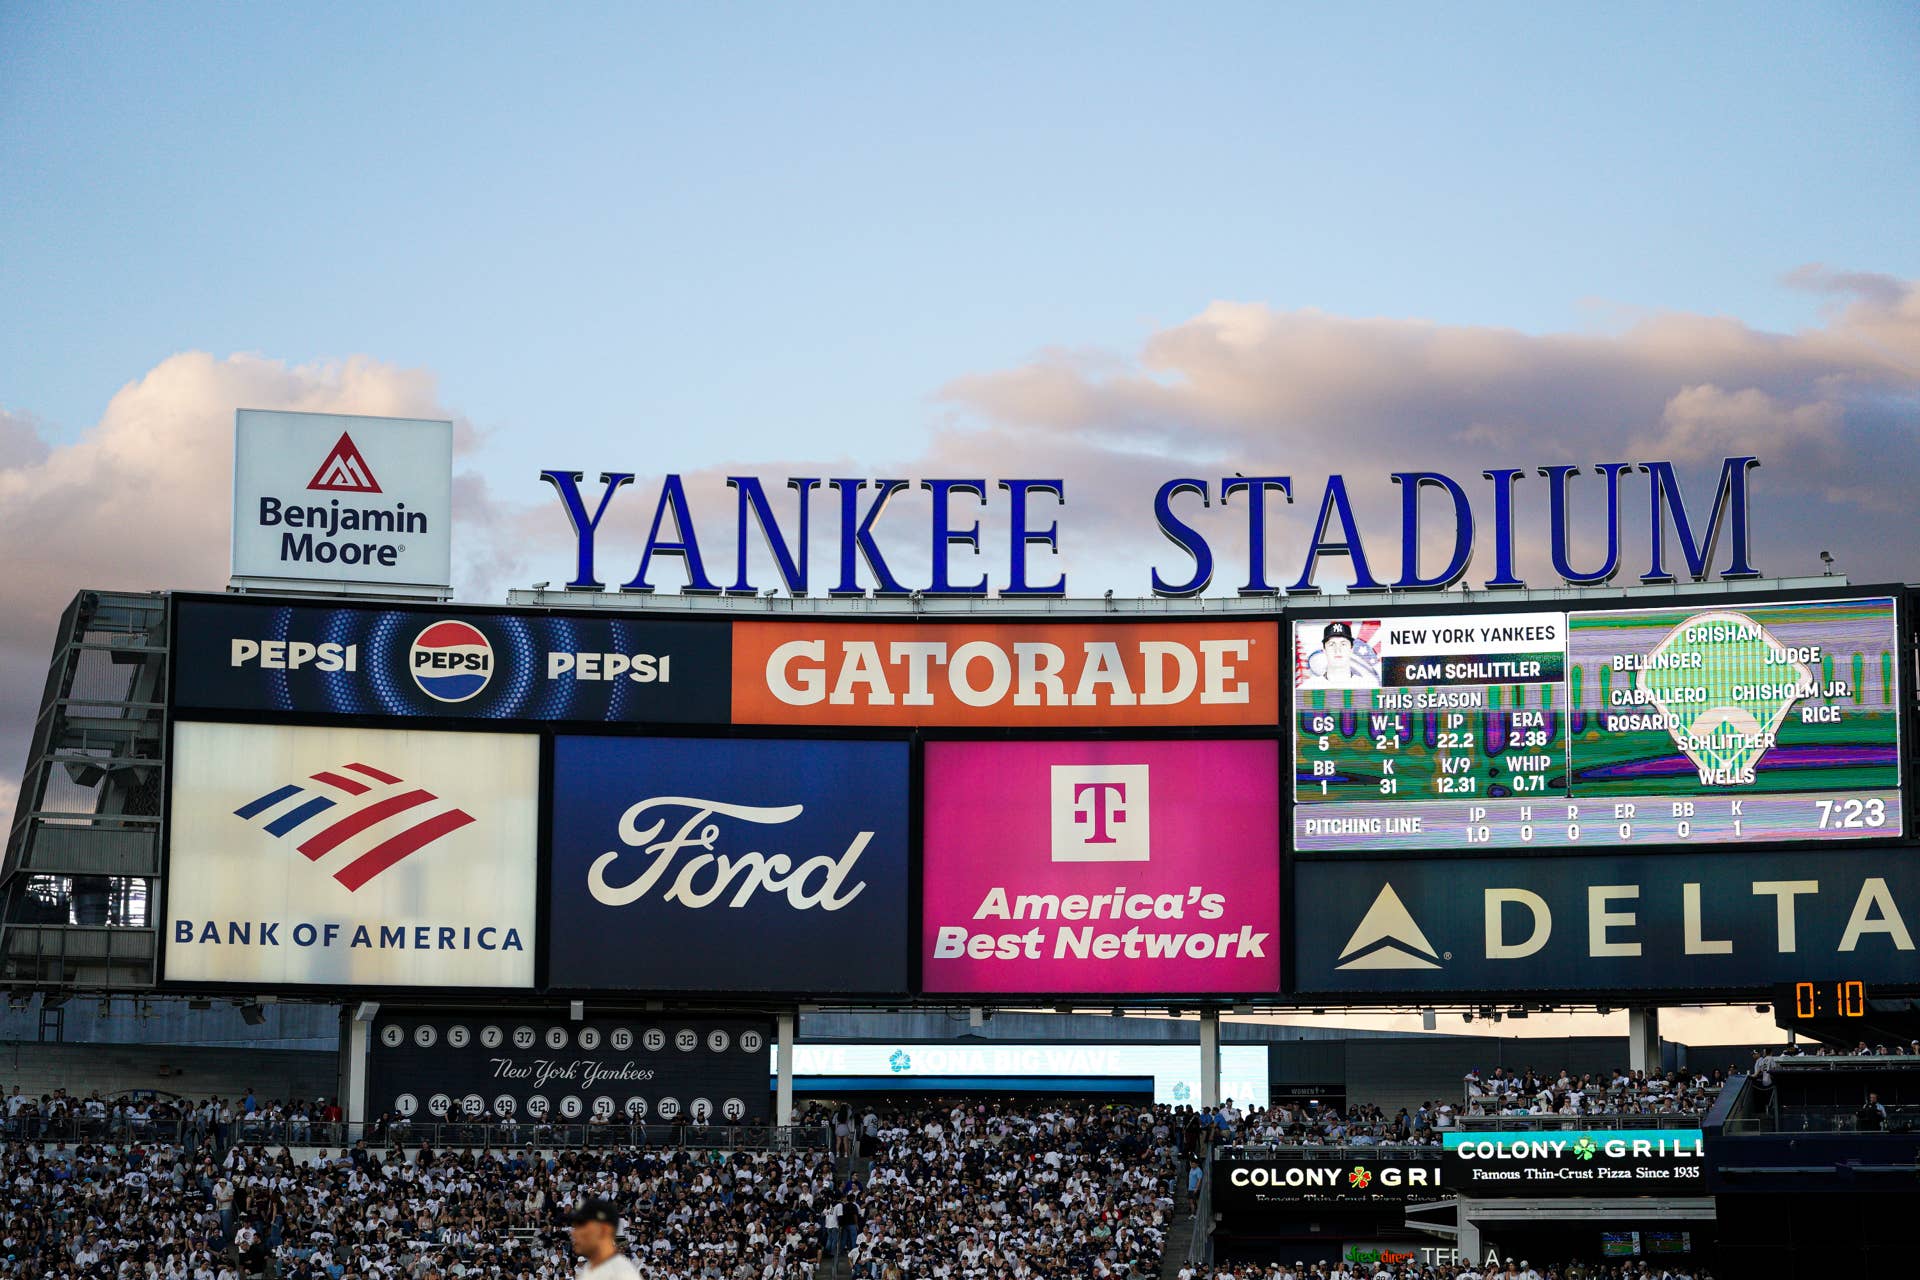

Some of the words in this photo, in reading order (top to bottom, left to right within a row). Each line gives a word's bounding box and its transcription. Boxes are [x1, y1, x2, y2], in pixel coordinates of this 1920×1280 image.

[259, 497, 428, 538] Benjamin
[540, 470, 1066, 598] YANKEE
[1151, 455, 1763, 598] STADIUM
[1390, 630, 1427, 645] NEW
[1432, 629, 1474, 643] YORK
[1482, 626, 1555, 642] YANKEES
[1685, 625, 1762, 644] GRISHAM
[231, 638, 357, 672] PEPSI
[414, 651, 490, 672] PEPSI
[1613, 653, 1702, 670] BELLINGER
[1764, 647, 1821, 664] JUDGE
[547, 651, 670, 683] PEPSI
[766, 639, 1250, 707] GATORADE
[1405, 664, 1441, 680] CAM
[1445, 660, 1540, 679] SCHLITTLER
[1377, 694, 1413, 709] THIS
[1417, 693, 1482, 707] SEASON
[1611, 687, 1706, 705] CABALLERO
[1732, 683, 1819, 700] CHISHOLM
[1823, 682, 1852, 698] JR.
[1313, 717, 1334, 732] GS
[1372, 714, 1404, 731] W-L
[1448, 714, 1464, 729] IP
[1512, 712, 1544, 727] ERA
[1607, 714, 1680, 731] ROSARIO
[1802, 707, 1841, 723] RICE
[1319, 736, 1329, 751] 5
[1376, 735, 1399, 749] 2-1
[1437, 734, 1473, 748] 22.2
[1509, 731, 1546, 747] 2.38
[1677, 733, 1776, 750] SCHLITTLER
[1313, 761, 1335, 775] BB
[1383, 760, 1394, 774] K
[1441, 757, 1471, 773] K/9
[1506, 756, 1550, 771] WHIP
[1321, 780, 1327, 795] 1
[1380, 779, 1396, 794] 31
[1437, 778, 1475, 792] 12.31
[1513, 775, 1545, 791] 0.71
[1699, 768, 1755, 785] WELLS
[1074, 783, 1127, 844] T
[1470, 808, 1486, 822] IP
[1521, 806, 1531, 821] H
[1568, 806, 1578, 820] R
[1615, 804, 1635, 819] ER
[1672, 802, 1694, 817] BB
[1732, 801, 1742, 816] K
[1815, 799, 1886, 829] 7:23
[1305, 818, 1382, 834] PITCHING
[1386, 816, 1421, 832] LINE
[1466, 826, 1489, 842] 1.0
[1521, 825, 1532, 841] 0
[1568, 824, 1579, 840] 0
[1620, 824, 1630, 839] 0
[1678, 822, 1689, 837] 0
[1734, 821, 1741, 835] 1
[588, 795, 875, 912] Ford
[1485, 877, 1916, 959] DELTA
[175, 919, 280, 946] BANK
[292, 922, 341, 948] OF
[351, 924, 524, 951] AMERICA
[933, 927, 1044, 960] Best
[1052, 925, 1270, 960] Network
[1796, 981, 1864, 1018] 0:10
[388, 1030, 396, 1041] 4
[422, 1031, 429, 1041] 3
[455, 1031, 462, 1042] 5
[488, 1032, 496, 1042] 7
[517, 1032, 532, 1043] 37
[553, 1032, 560, 1043] 8
[585, 1033, 593, 1044] 8
[615, 1033, 628, 1045] 16
[648, 1034, 660, 1045] 15
[679, 1035, 694, 1046] 32
[715, 1036, 722, 1047] 9
[745, 1036, 757, 1047] 10
[771, 1048, 848, 1072] AVE
[912, 1050, 987, 1071] KONA
[994, 1050, 1036, 1071] BIG
[1045, 1049, 1120, 1071] WAVE
[489, 1058, 532, 1078] New
[534, 1060, 580, 1088] York
[582, 1061, 655, 1089] Yankees
[404, 1100, 409, 1110] 1
[432, 1100, 449, 1111] 44
[465, 1100, 481, 1111] 23
[497, 1101, 512, 1112] 49
[530, 1101, 545, 1112] 42
[566, 1100, 576, 1114] 6
[598, 1102, 610, 1113] 51
[629, 1102, 643, 1113] 46
[662, 1103, 676, 1113] 20
[728, 1104, 740, 1115] 21
[1457, 1140, 1567, 1159] COLONY
[1604, 1139, 1705, 1158] GRILL
[1231, 1168, 1342, 1186] COLONY
[1473, 1169, 1521, 1180] Famous
[1524, 1168, 1593, 1179] Thin-Crust
[1598, 1168, 1632, 1179] Pizza
[1636, 1167, 1669, 1178] Since
[1674, 1166, 1700, 1178] 1935
